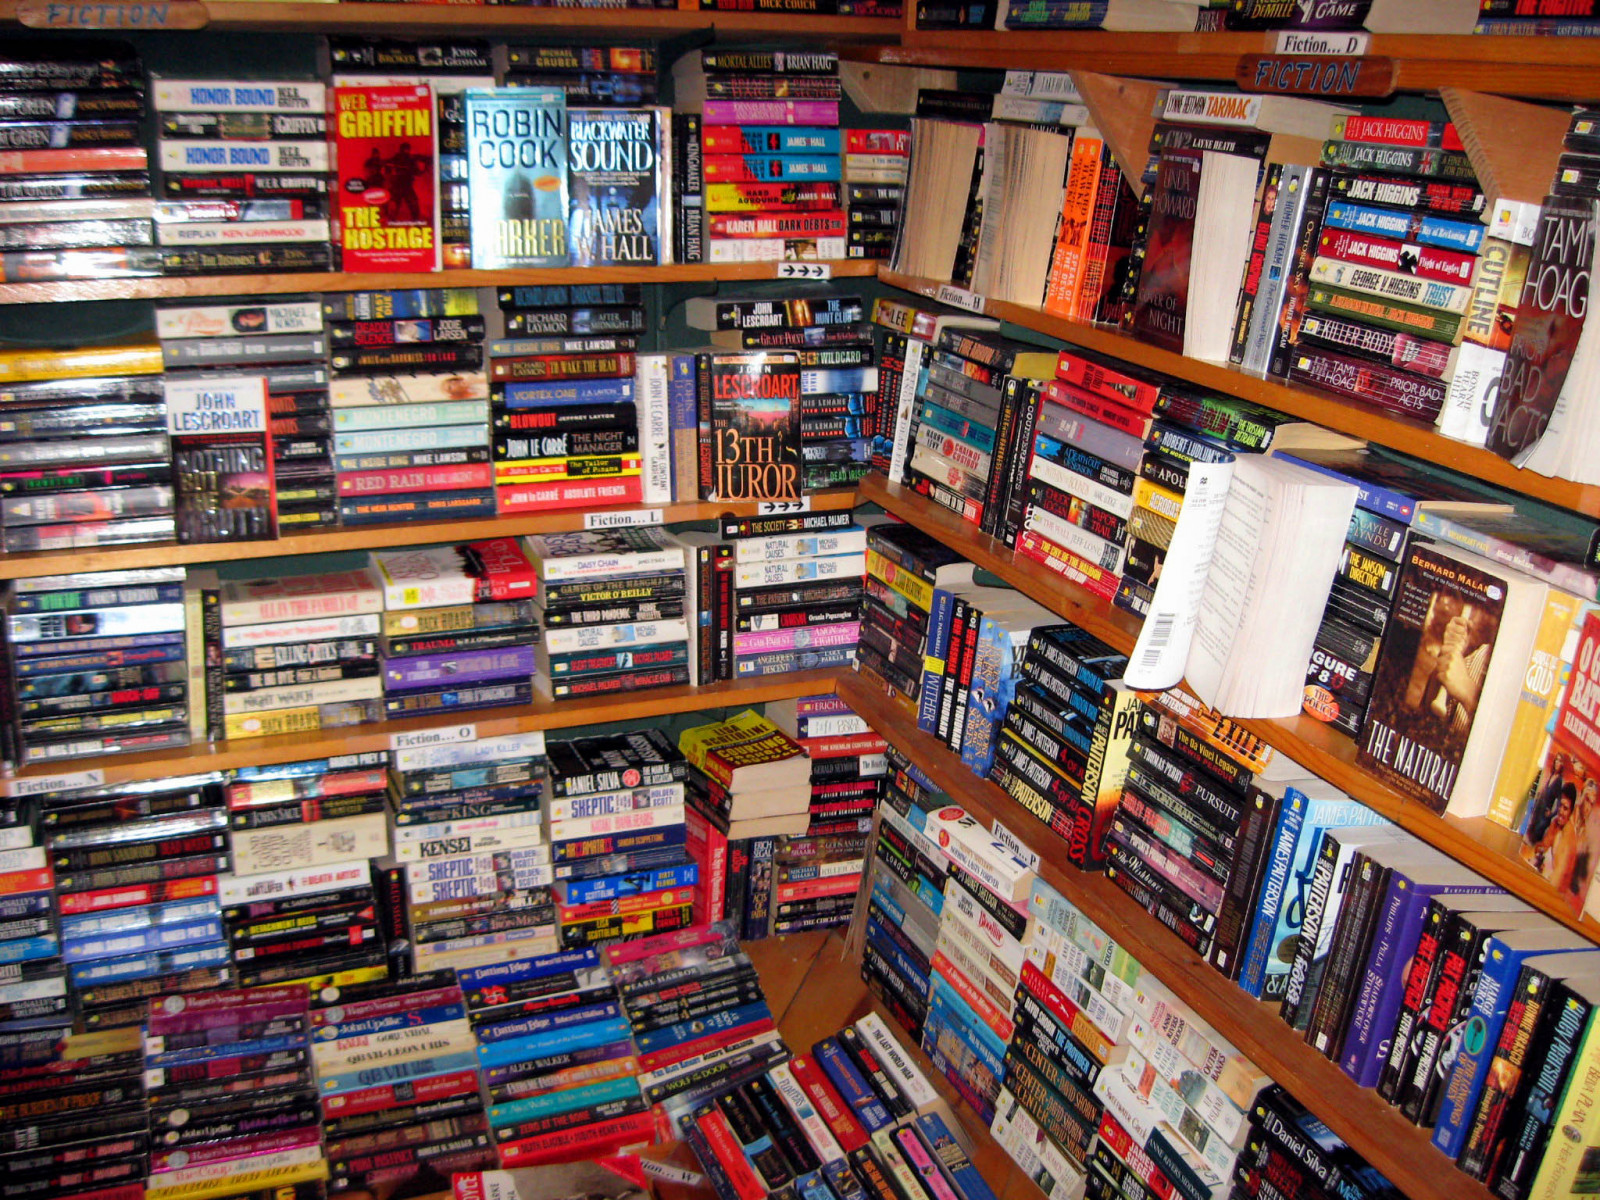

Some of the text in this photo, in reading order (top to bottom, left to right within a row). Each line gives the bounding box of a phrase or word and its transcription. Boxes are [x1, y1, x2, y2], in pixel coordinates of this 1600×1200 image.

[47, 3, 169, 25] FICTION
[1315, 3, 1356, 19] GAME
[1284, 36, 1358, 54] Fiction... D
[536, 56, 579, 68] GRUBER
[786, 56, 812, 69] BRIAN
[813, 55, 832, 70] HAIG
[1255, 60, 1361, 93] FICTION
[190, 87, 275, 107] HONOR BOUND
[339, 109, 431, 139] GRIFFIN
[473, 109, 563, 138] ROBIN
[570, 122, 650, 142] BLACKWATER
[1360, 119, 1424, 141] JACK HIGGINS
[786, 137, 826, 147] JAMES HALL
[186, 147, 270, 165] HONOR BOUND
[479, 140, 559, 170] COOK
[570, 140, 654, 173] SOUND
[1352, 148, 1413, 168] JACK HIGGINS
[1164, 169, 1190, 192] LINDA
[1347, 179, 1420, 207] JACK HIGGINS
[342, 207, 381, 228] THE
[1153, 197, 1195, 220] HOWARD
[1355, 210, 1409, 233] JACK HIGGINS
[178, 230, 218, 240] REPLAY
[344, 227, 433, 250] HOSTAGE
[1543, 216, 1588, 268] TAMI
[939, 287, 980, 310] Fiction... H
[1466, 245, 1508, 338] CUTLINE
[1521, 262, 1590, 320] HOAG
[742, 313, 784, 329] LESCROART
[890, 311, 907, 328] LEE
[1149, 309, 1183, 336] NIGHT
[433, 328, 469, 341] LARSEN
[1321, 319, 1396, 357] KILLER BODY
[820, 350, 861, 365] WILDCARD
[713, 374, 799, 400] LESCROART
[1389, 375, 1441, 402] PRIOR BAD
[1499, 357, 1542, 404] BAD
[195, 392, 237, 410] JOHN
[513, 388, 578, 401] VORTEX ONE
[1397, 392, 1424, 411] ACTS
[172, 409, 261, 432] LESCROART
[351, 406, 437, 424] MONTENEGRO
[1491, 404, 1548, 449] ACTS
[354, 431, 438, 450] MONTENEGRO
[571, 431, 624, 443] THE NIGHT
[925, 425, 944, 444] HARRY
[573, 441, 623, 452] MANAGER
[714, 429, 775, 465] 13TH
[1014, 404, 1035, 492] COUNTERPARTS
[952, 450, 980, 471] CUSTODY
[355, 475, 425, 491] RED RAIN
[716, 463, 797, 502] JUROR
[589, 510, 661, 529] Fiction... L
[1091, 519, 1112, 540] TRAIL
[1355, 527, 1389, 550] LYNDS
[1411, 554, 1456, 580] BERNARD
[1349, 566, 1379, 592] DIRECTIVE
[814, 700, 837, 711] ERICH
[921, 674, 940, 723] WITHER
[1303, 696, 1337, 720] POLICY
[261, 713, 319, 735] BACK ROADS
[714, 724, 738, 737] LISA
[1562, 710, 1587, 743] HARRY
[395, 727, 470, 747] Fiction... O
[715, 735, 788, 759] COURTING
[1080, 731, 1108, 807] PATTERSON
[1366, 719, 1457, 801] THE NATURAL
[16, 773, 97, 796] Fiction... N
[566, 771, 621, 796] DANIEL SILVA
[1143, 747, 1241, 823] THOMAS PERRY PURSUIT
[571, 795, 615, 819] SKEPTIC
[420, 836, 472, 858] KENSEI
[753, 840, 773, 851] ERICH
[993, 823, 1037, 867] Fiction... P
[1280, 822, 1296, 852] JAMES
[753, 849, 773, 859] SEGAL
[879, 851, 910, 880] Loaded
[308, 872, 334, 885] DEATH
[335, 869, 361, 882] ARTIST
[429, 858, 474, 881] SKEPTIC
[822, 865, 845, 876] KILLER
[1116, 850, 1165, 894] The Wishbones
[432, 876, 478, 901] SKEPTIC
[1259, 850, 1290, 921] PATTERSON
[1300, 862, 1333, 944] PATTERSON
[1103, 939, 1116, 968] COLONY
[1482, 979, 1501, 1018] MARGE
[492, 1017, 551, 1038] Cutting Edge
[1425, 1030, 1438, 1055] STEVE
[1538, 997, 1587, 1095] Ridley Pearson
[508, 1053, 571, 1073] ALICE WALKER
[872, 1028, 914, 1081] THE LAST WORLD WAR
[1202, 1047, 1219, 1076] OUTER
[701, 1062, 729, 1079] DOOR
[665, 1078, 691, 1091] WOLF
[1128, 1139, 1154, 1172] JAMES
[1271, 1117, 1327, 1180] Daniel Silva
[1124, 1150, 1151, 1184] SIEGEL
